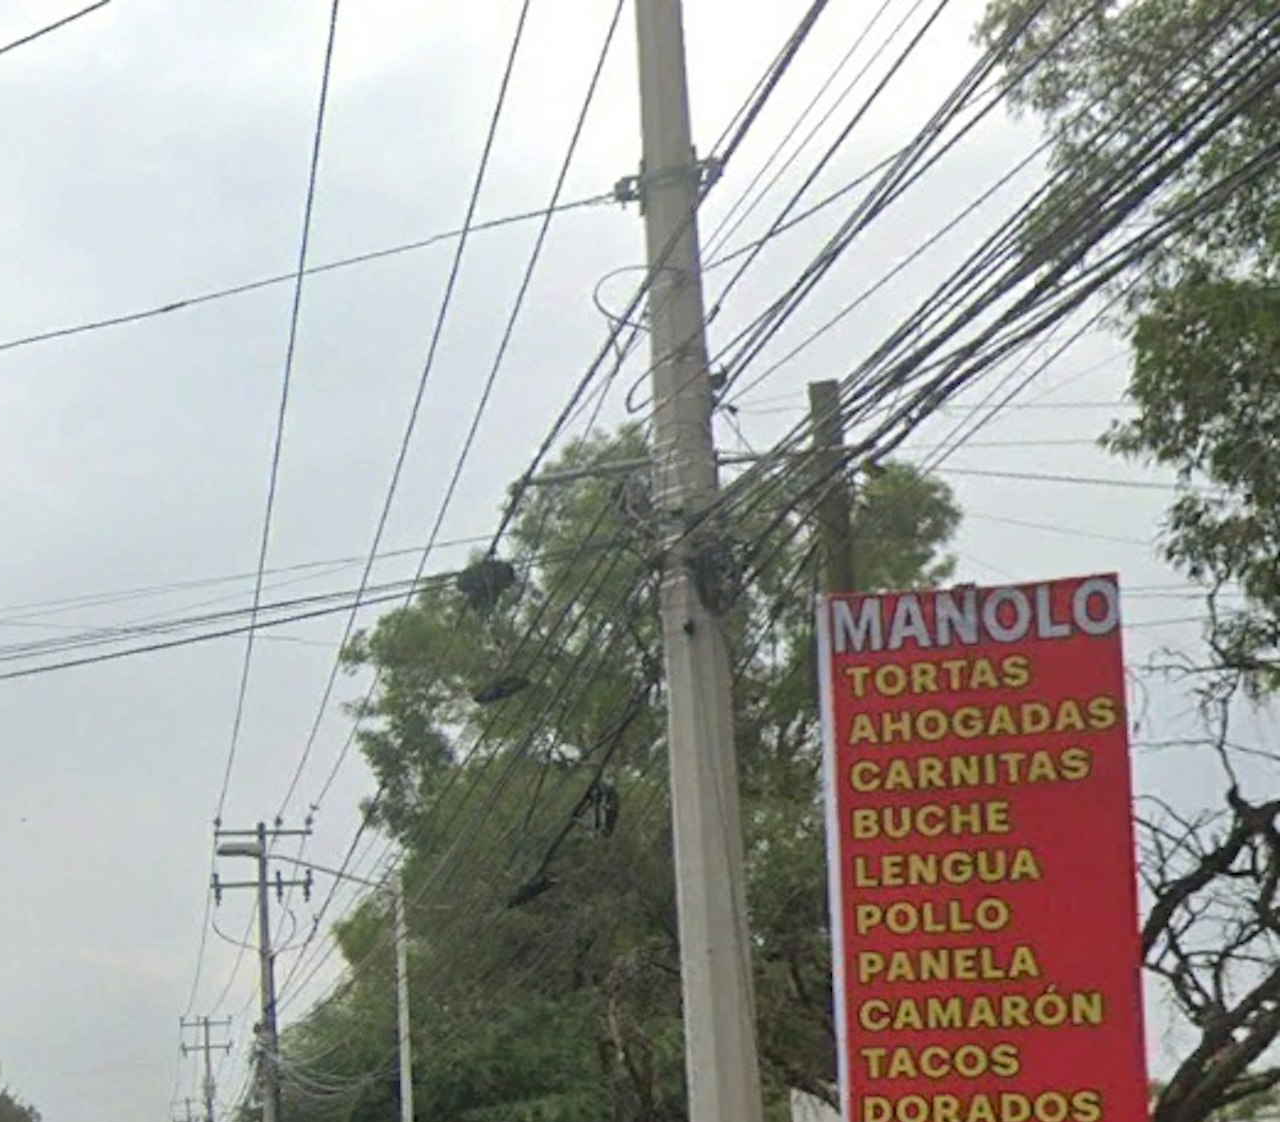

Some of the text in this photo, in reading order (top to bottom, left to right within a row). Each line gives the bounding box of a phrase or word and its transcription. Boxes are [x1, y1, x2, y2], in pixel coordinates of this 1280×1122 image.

[831, 578, 1119, 653] MANOLO
[846, 655, 1030, 698] TORTAS
[849, 696, 1117, 744] AHOGADAS
[850, 748, 1092, 792] CARNITAS
[851, 800, 1011, 839] BUCHE
[854, 848, 1041, 888] LENGUA
[855, 897, 1011, 935] POLLO
[858, 945, 1040, 984] PANELA
[858, 984, 1104, 1032] CAMARÓN
[860, 1043, 1021, 1080] TACOS
